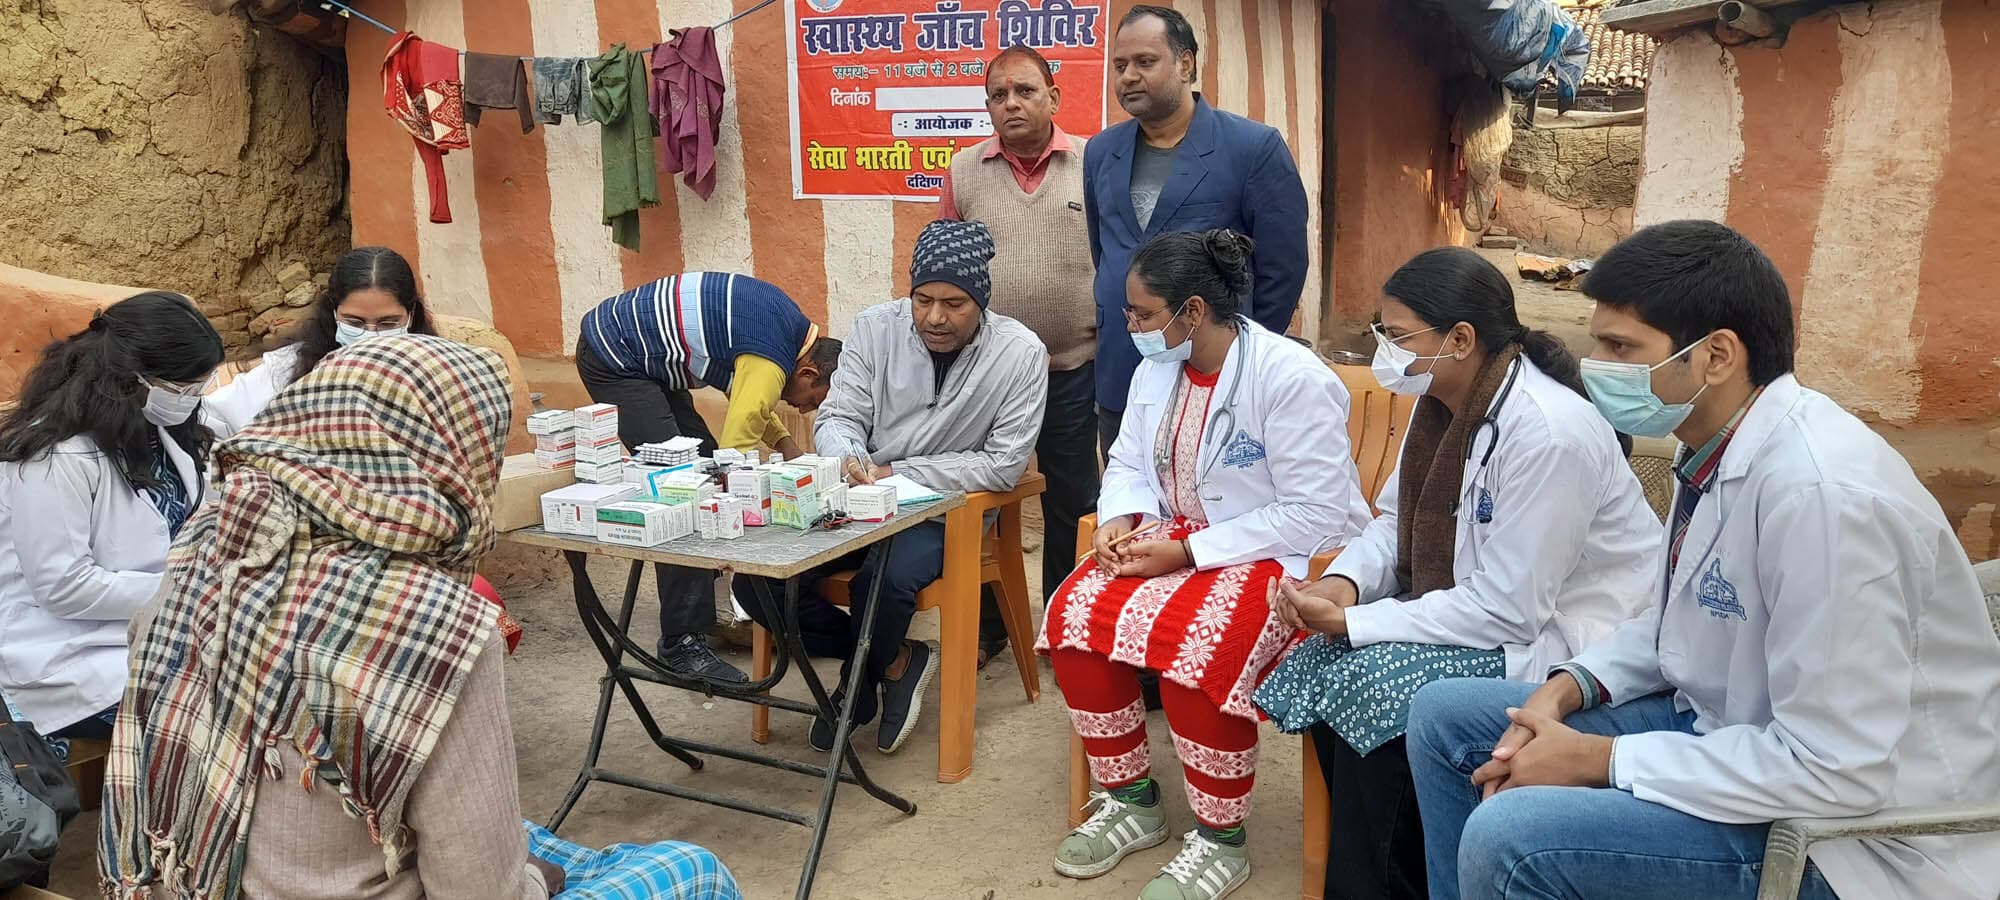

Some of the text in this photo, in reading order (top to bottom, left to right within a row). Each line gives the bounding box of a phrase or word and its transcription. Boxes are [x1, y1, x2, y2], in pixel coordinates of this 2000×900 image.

[801, 14, 905, 54] स्वास्थ्य
[996, 0, 1099, 48] शिविर
[885, 64, 900, 77] 11
[905, 60, 928, 77] बजे
[931, 59, 944, 77] से
[947, 63, 957, 77] 2
[960, 58, 984, 76] बजे
[1047, 60, 1061, 75] क
[830, 87, 871, 106] दिनांक
[914, 115, 973, 130] आयोजक
[807, 139, 956, 170] सेवा भारती एवं
[906, 173, 944, 189] दक्षिण
